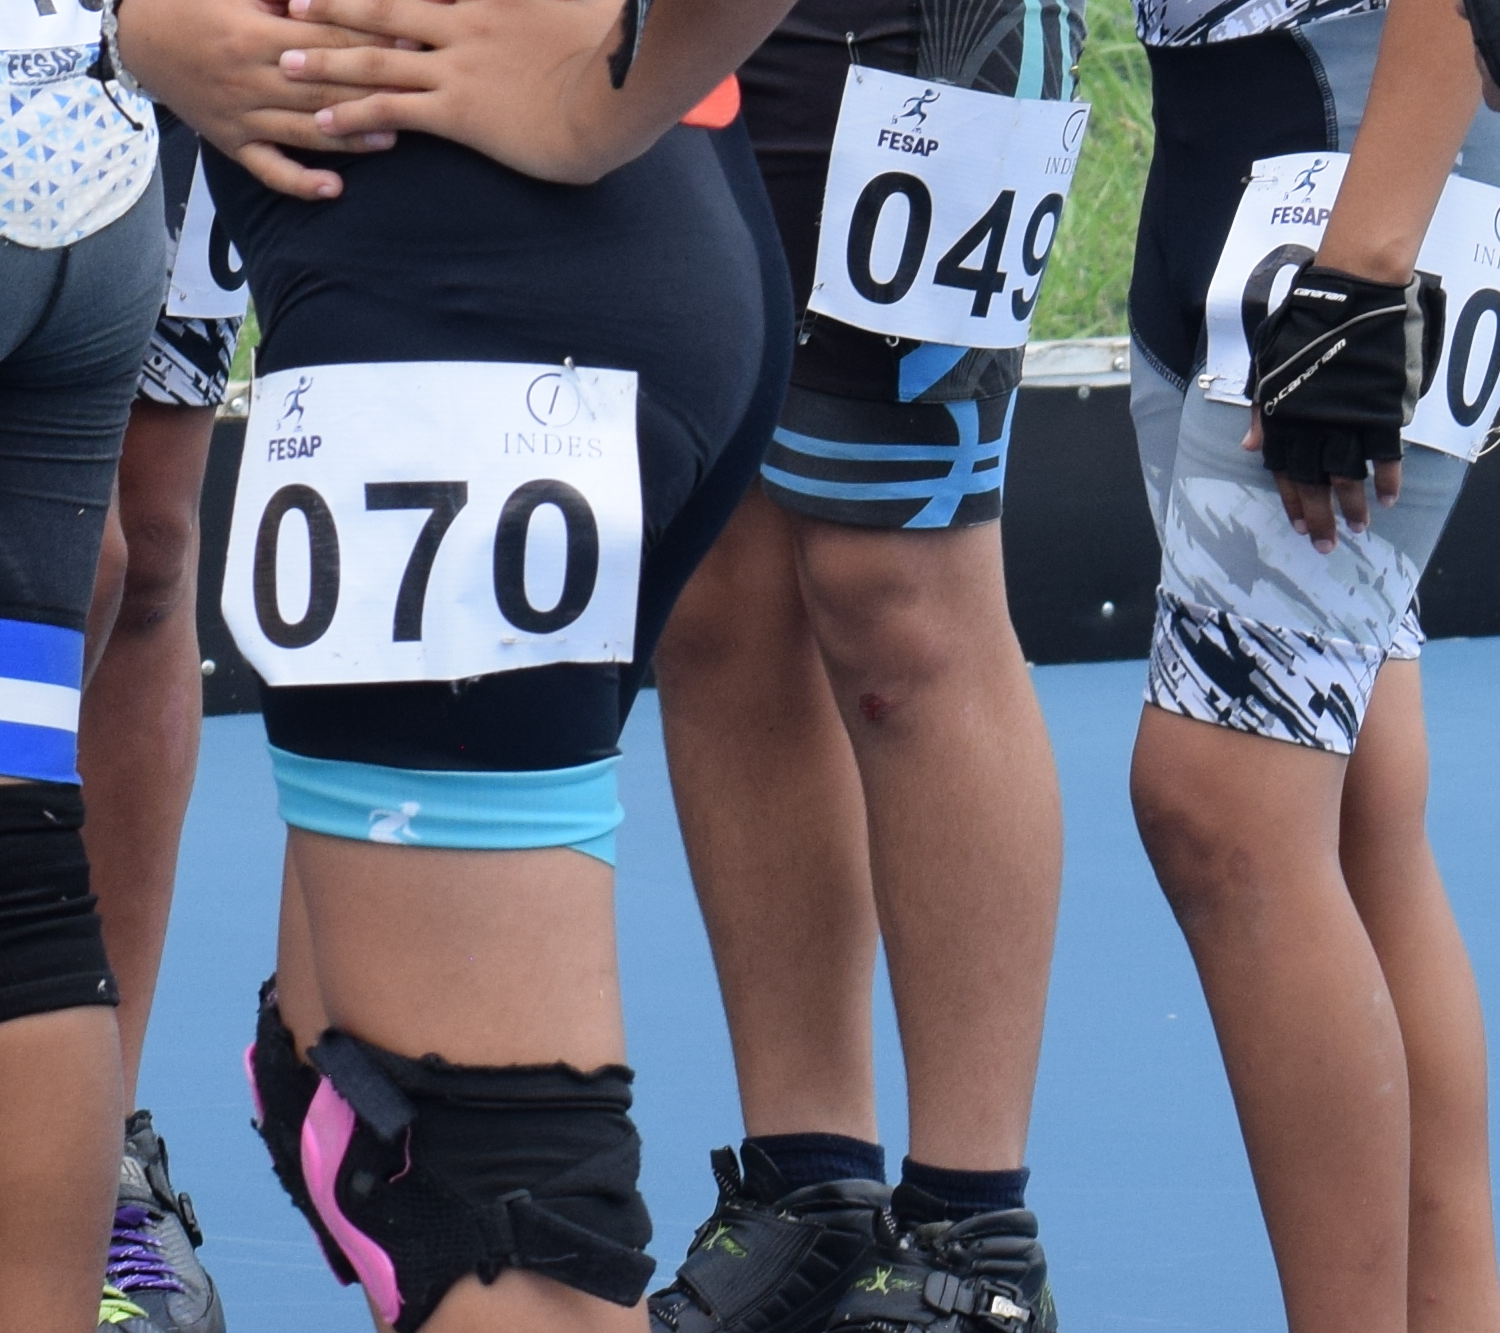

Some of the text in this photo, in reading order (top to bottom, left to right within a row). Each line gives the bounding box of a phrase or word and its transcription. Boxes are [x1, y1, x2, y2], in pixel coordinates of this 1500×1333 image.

[7, 47, 83, 80] FESAP
[877, 128, 939, 157] FESAP
[1270, 205, 1330, 227] FESAP
[846, 171, 1065, 321] 049
[267, 435, 323, 462] FESAP
[503, 432, 604, 459] INDES
[252, 478, 600, 649] 070
